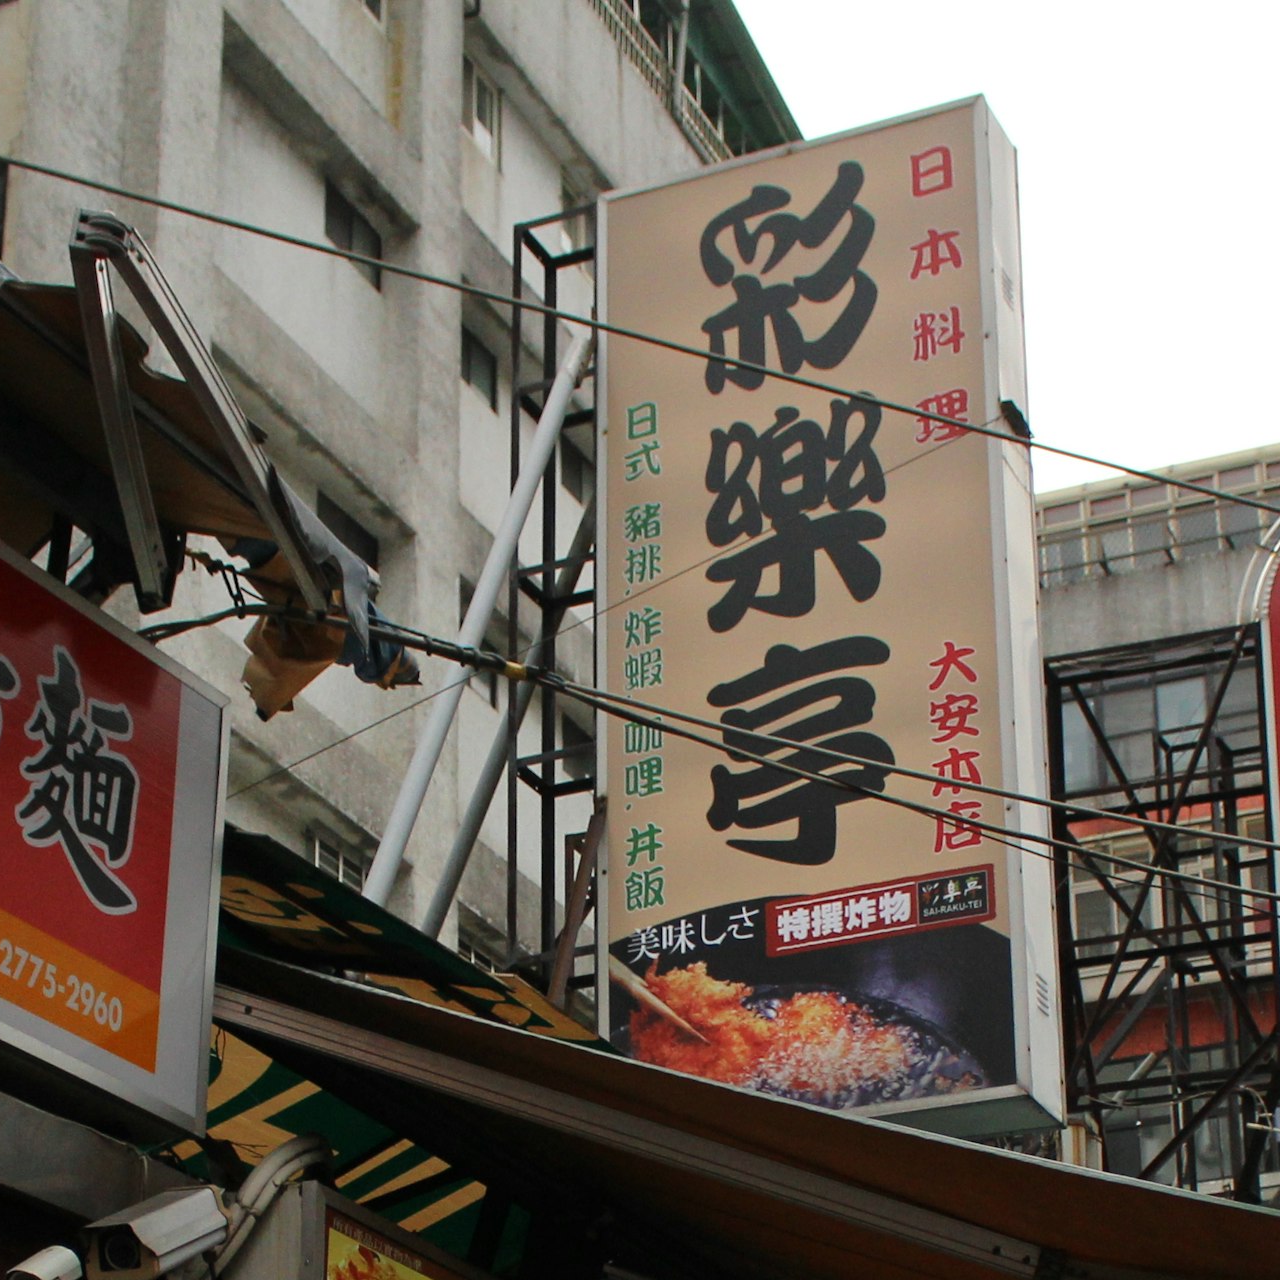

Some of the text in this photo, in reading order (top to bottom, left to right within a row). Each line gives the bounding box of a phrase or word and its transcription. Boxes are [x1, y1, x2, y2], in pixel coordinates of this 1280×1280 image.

[909, 145, 970, 445] 日本料理
[699, 160, 896, 866] 彩樂亭
[928, 640, 984, 854] 大安本店
[626, 905, 762, 965] 美味しさ
[775, 890, 913, 942] 特撰炸物
